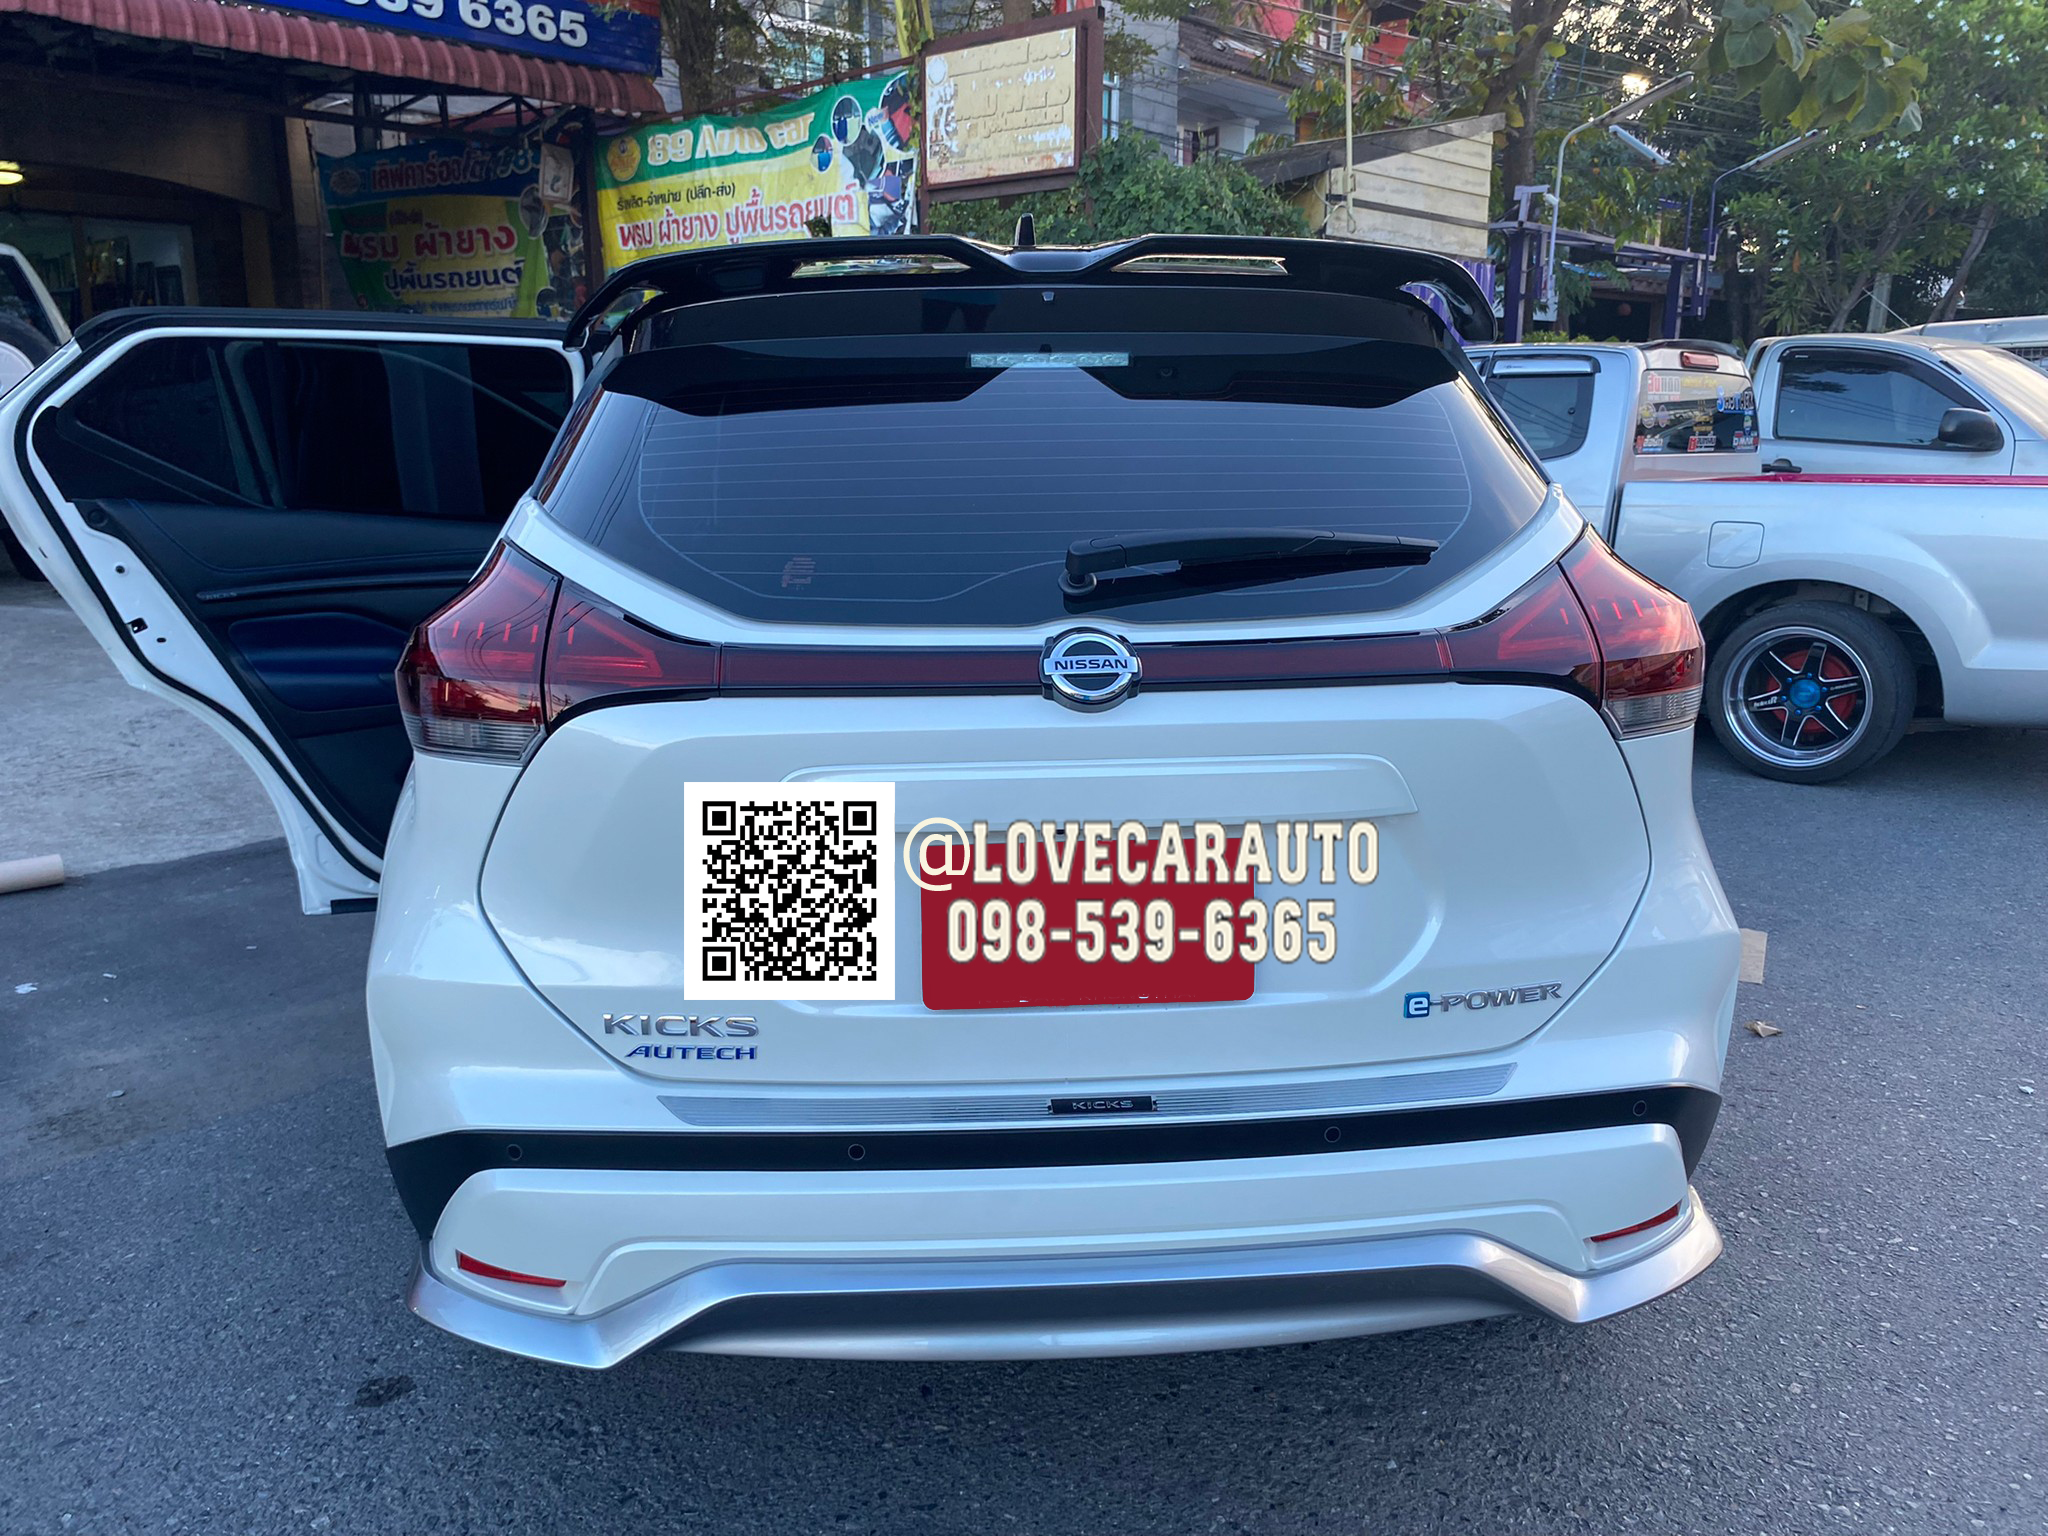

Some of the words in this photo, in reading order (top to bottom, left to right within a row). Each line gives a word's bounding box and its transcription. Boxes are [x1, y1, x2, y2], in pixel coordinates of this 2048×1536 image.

[457, 0, 589, 48] 6365
[647, 129, 694, 166] 89
[695, 124, 768, 159] Auto
[414, 222, 518, 258] ผ้ายาง
[658, 208, 720, 244] ผ้ายาง
[1054, 658, 1129, 671] NISSAN
[1405, 981, 1563, 1016] e-POWER
[602, 1013, 759, 1037] KICKS
[625, 1044, 758, 1060] AUTECH
[1072, 1100, 1134, 1110] KICKS
